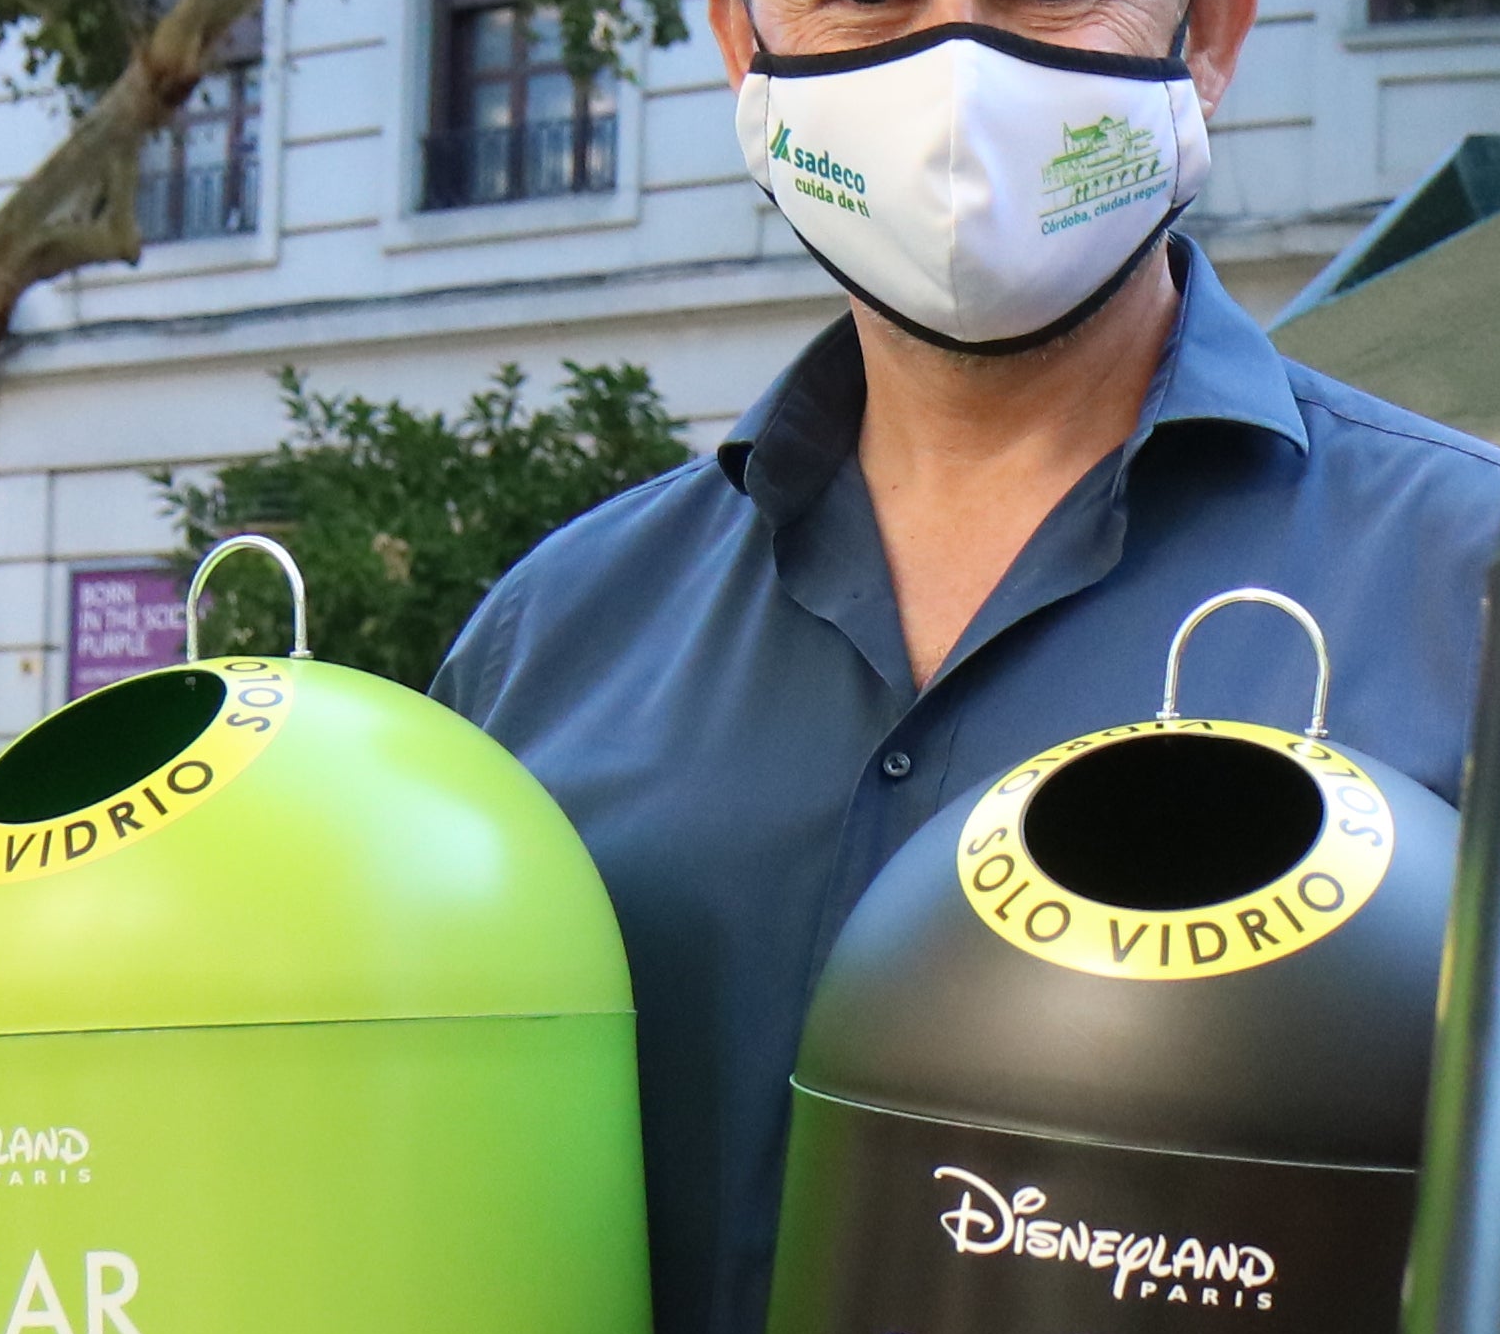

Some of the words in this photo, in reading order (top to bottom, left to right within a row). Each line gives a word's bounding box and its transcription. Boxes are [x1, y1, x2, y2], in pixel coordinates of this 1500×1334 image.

[794, 147, 865, 195] sadeco
[795, 177, 834, 204] cuida
[838, 190, 854, 212] de
[857, 199, 870, 218] ti
[1041, 210, 1092, 235] Córdoba,
[1094, 192, 1132, 217] ciudad
[1134, 179, 1167, 200] segura
[5, 760, 213, 873] VIDRIO
[224, 661, 283, 733] SOLO
[967, 827, 1071, 944] SOLO
[1109, 871, 1345, 966] VIDRIO
[1140, 1281, 1274, 1310] PARIS
